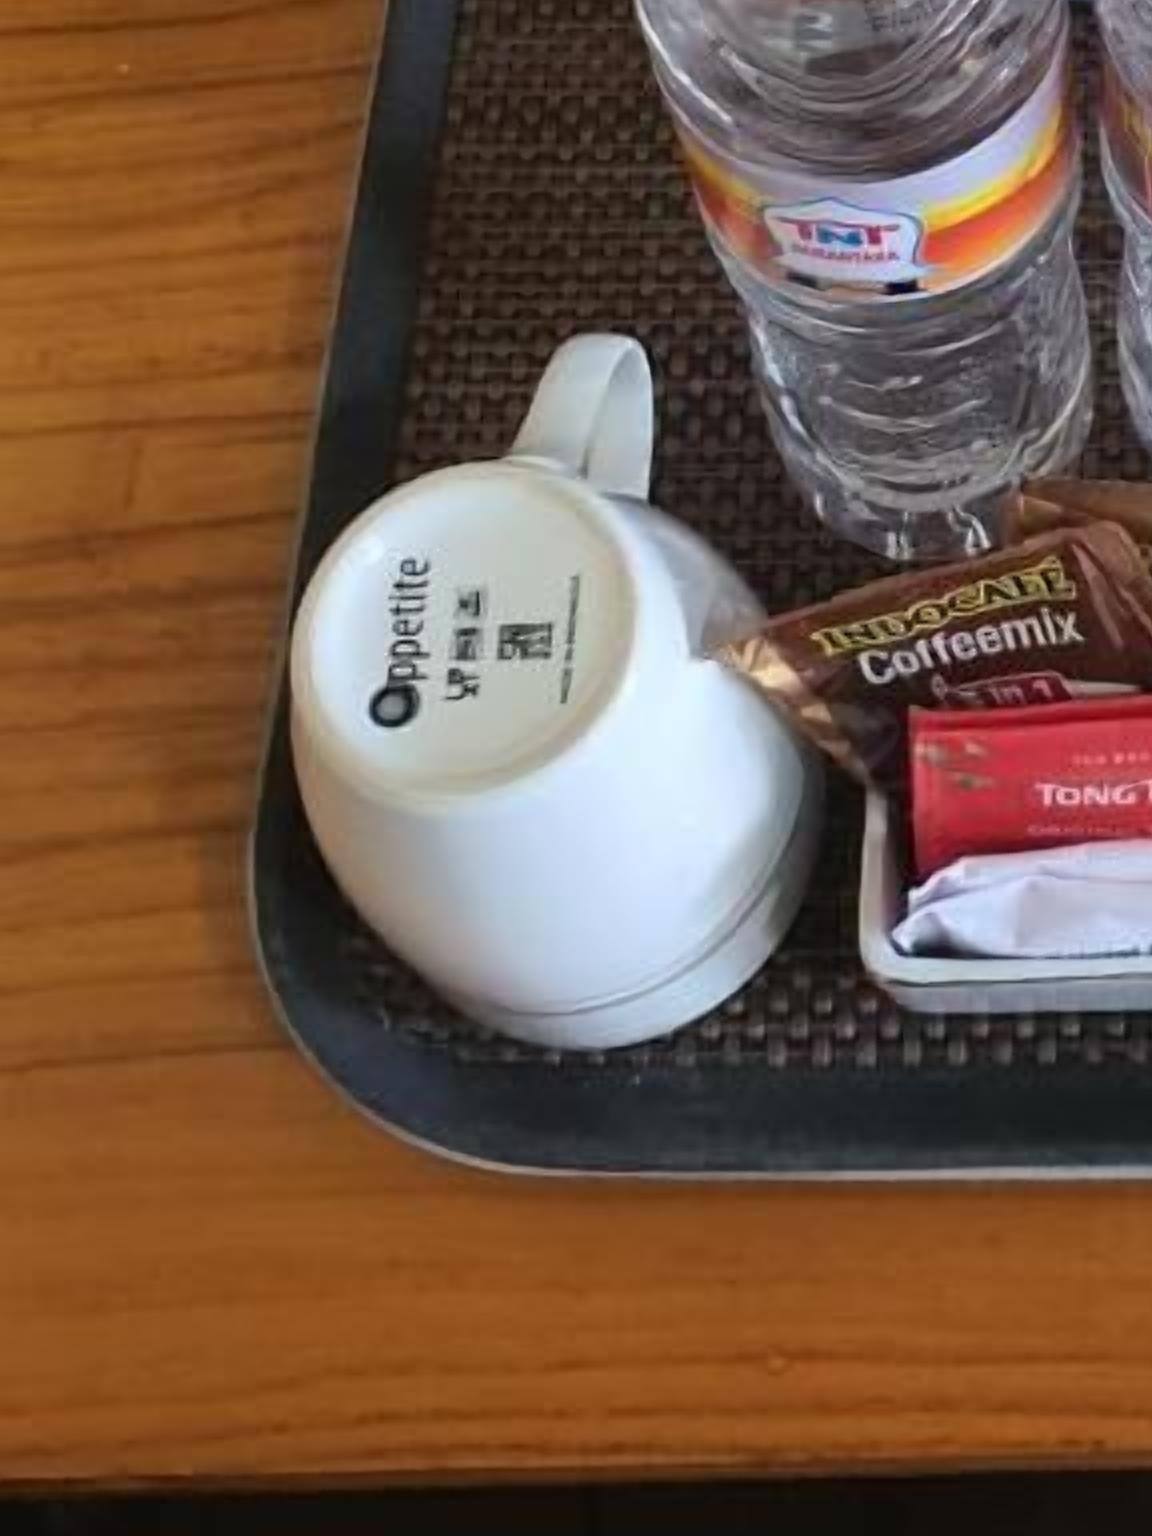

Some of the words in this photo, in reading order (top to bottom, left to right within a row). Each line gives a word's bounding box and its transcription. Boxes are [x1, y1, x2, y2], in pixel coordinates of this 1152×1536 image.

[774, 216, 900, 247] TNT
[858, 606, 1086, 685] Coffeemix
[1034, 781, 1139, 808] TONG
